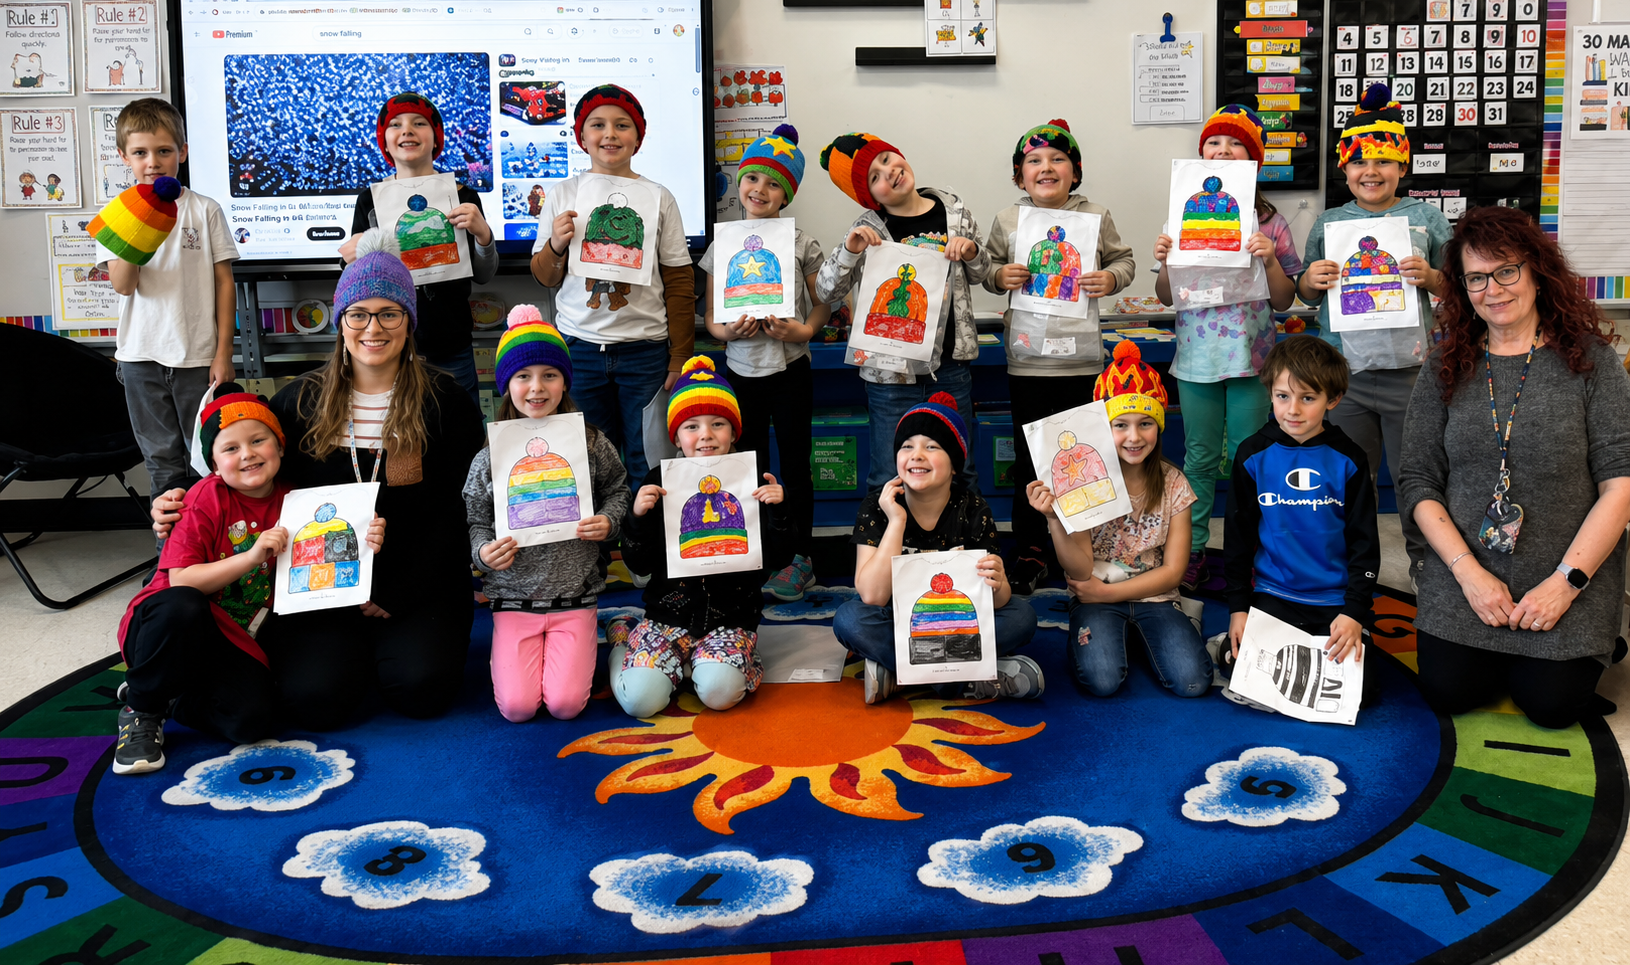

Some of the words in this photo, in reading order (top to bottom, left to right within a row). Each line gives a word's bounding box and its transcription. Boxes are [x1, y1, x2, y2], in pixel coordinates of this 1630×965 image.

[8, 8, 36, 25] Rule
[97, 6, 123, 22] Rule
[128, 6, 146, 22] #2
[1461, 3, 1471, 18] 7
[1492, 2, 1501, 18] 9
[1523, 2, 1534, 16] 0
[226, 30, 253, 39] Premium
[340, 30, 362, 39] falling
[1342, 32, 1353, 46] 4
[1372, 31, 1382, 45] 5
[1403, 31, 1413, 45] 6
[1430, 30, 1440, 44] 7
[1460, 30, 1471, 44] 8
[1490, 29, 1501, 44] 9
[1521, 29, 1537, 43] 10
[1582, 34, 1603, 49] 30
[1606, 34, 1630, 49] MA
[1341, 58, 1352, 72] 11
[1370, 57, 1385, 71] 12
[1400, 56, 1415, 70] 13
[1429, 56, 1444, 70] 14
[1458, 55, 1473, 69] 15
[1488, 55, 1503, 69] 16
[1519, 55, 1535, 69] 17
[1339, 83, 1353, 98] 18
[1395, 82, 1413, 97] 20
[1429, 82, 1445, 96] 21
[1457, 81, 1475, 95] 22
[1486, 81, 1505, 95] 23
[1516, 80, 1534, 94] 24
[13, 115, 41, 130] Rule
[45, 115, 63, 130] #3
[1426, 108, 1444, 122] 28
[1457, 107, 1477, 121] 30
[1488, 107, 1503, 121] 31
[231, 204, 251, 212] Snow
[252, 203, 278, 212] Falling
[232, 215, 253, 223] Snow
[254, 215, 281, 224] Falling
[1257, 492, 1345, 512] Champion
[1240, 775, 1297, 799] 5
[1459, 793, 1566, 839] J
[363, 845, 427, 876] 8
[674, 872, 724, 906] 7
[1374, 854, 1501, 915] K
[1245, 907, 1365, 961] L
